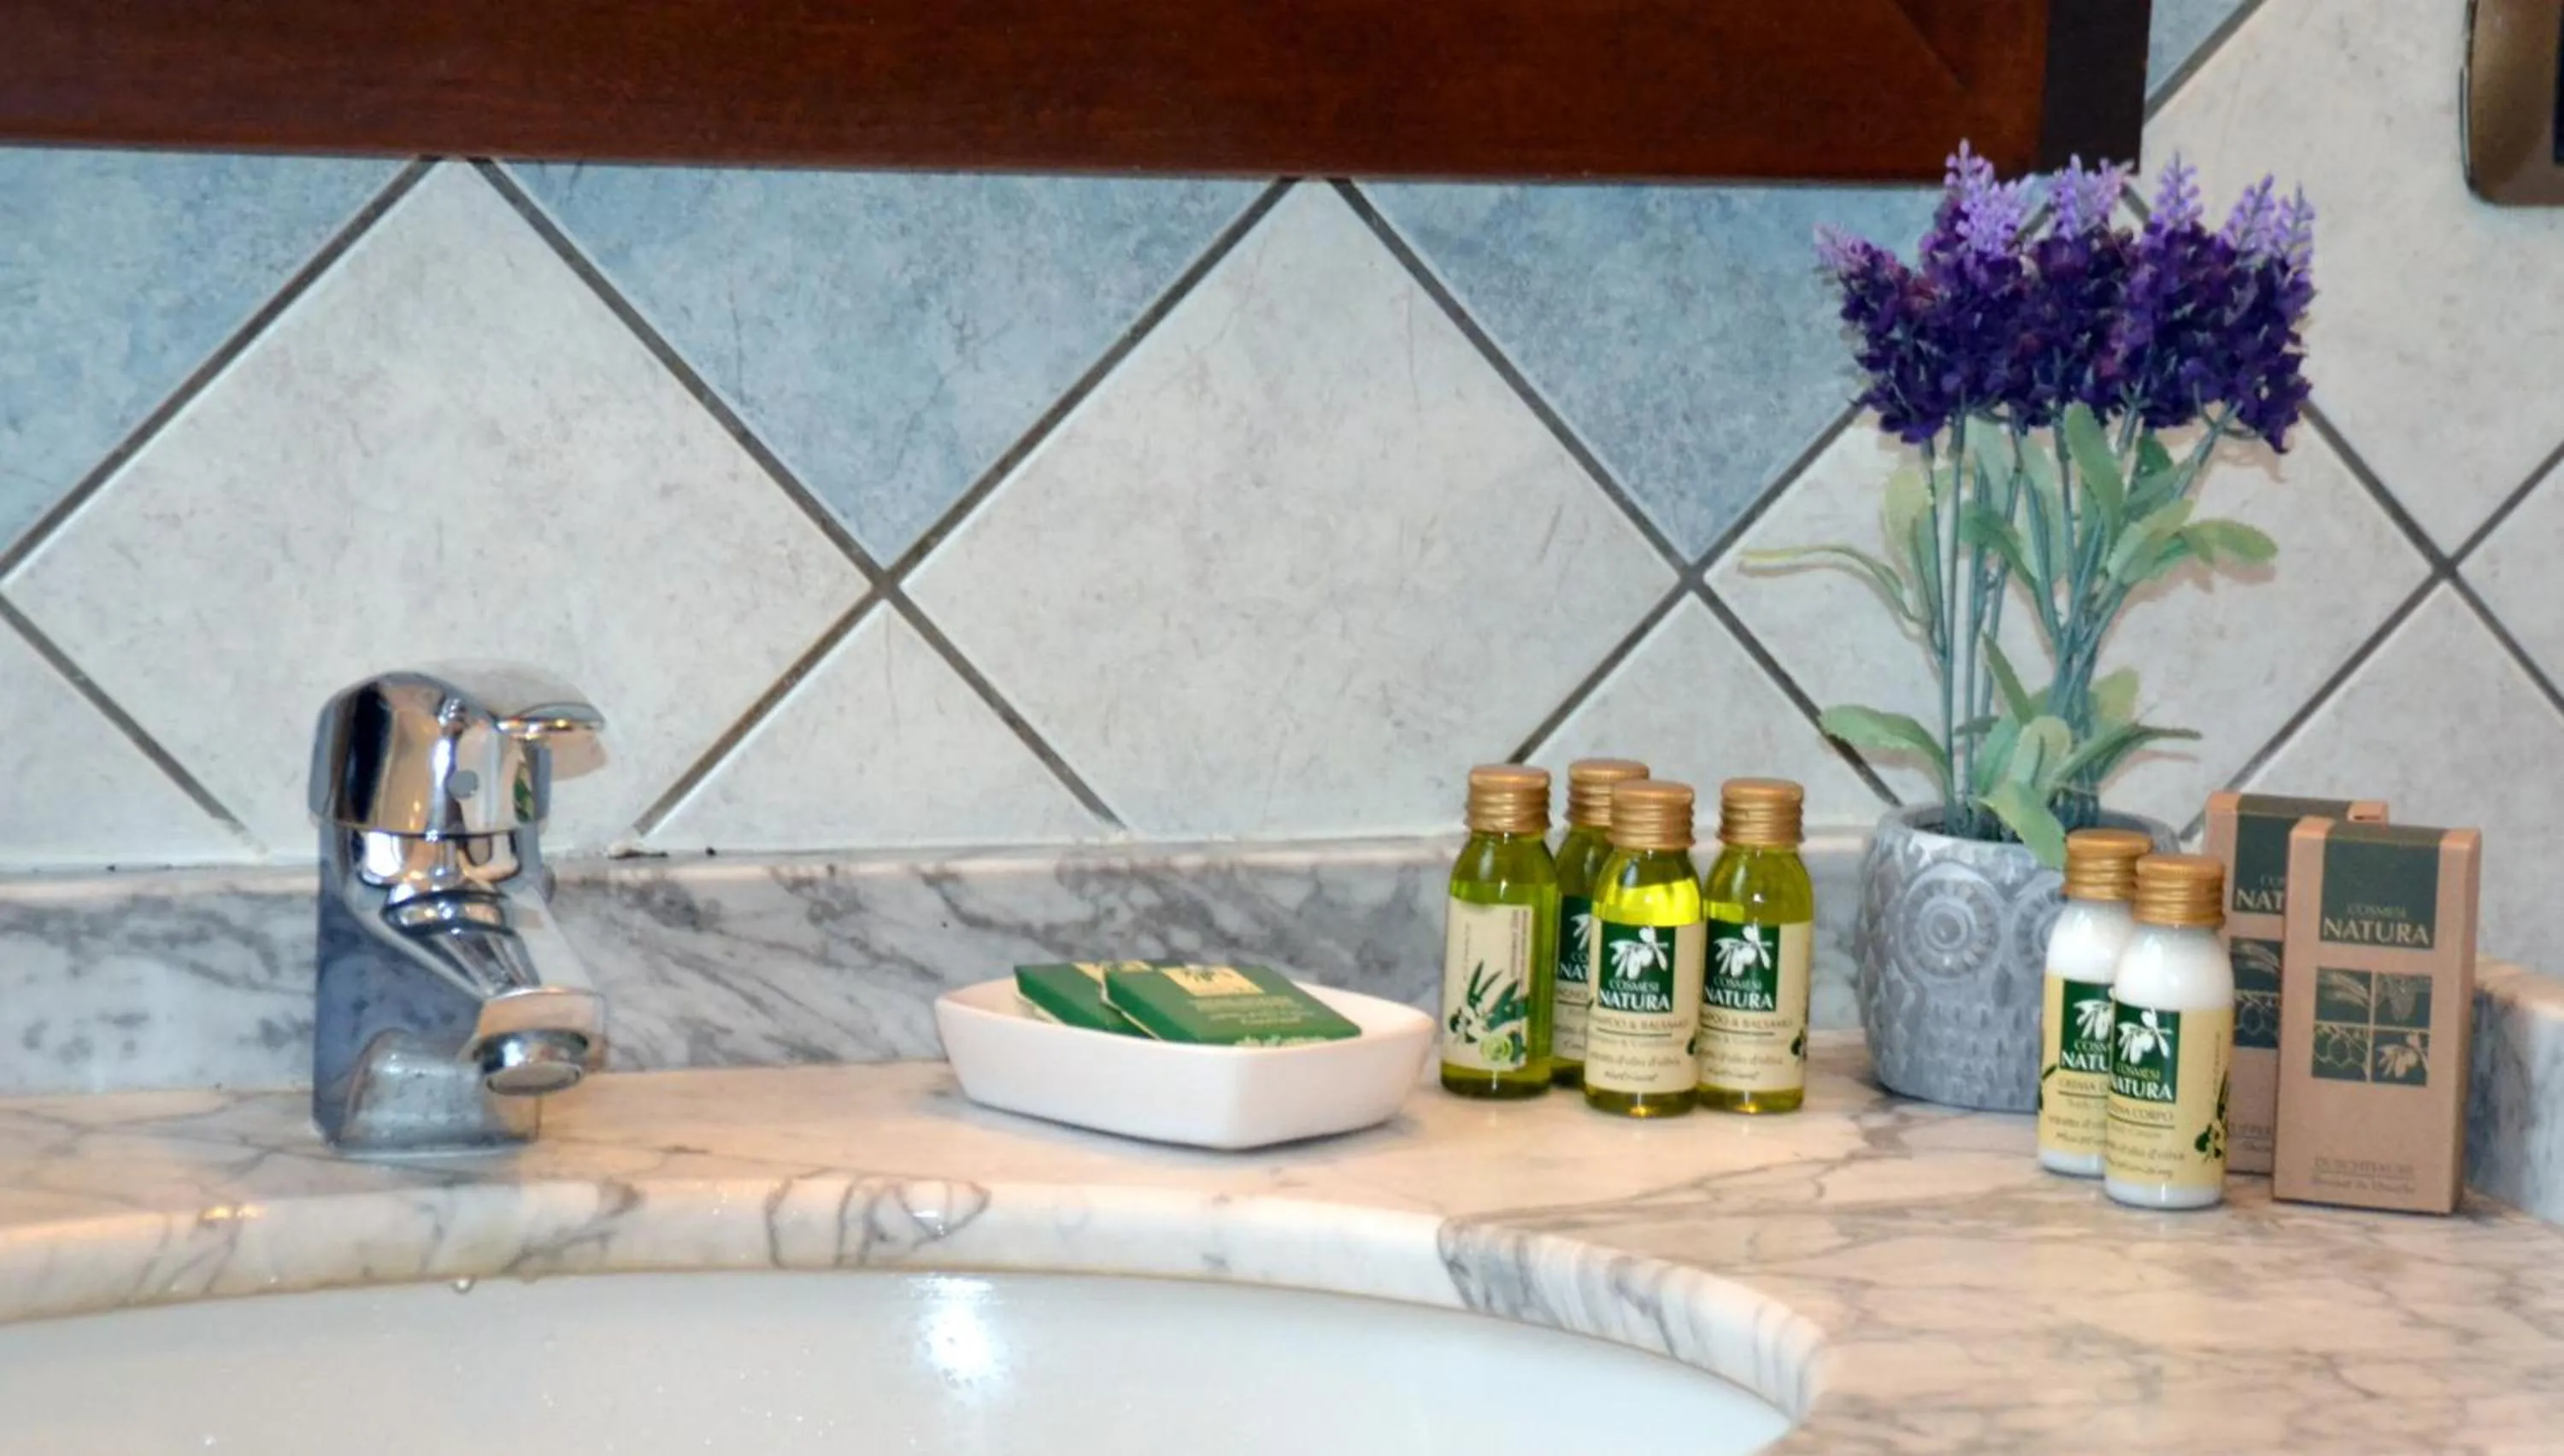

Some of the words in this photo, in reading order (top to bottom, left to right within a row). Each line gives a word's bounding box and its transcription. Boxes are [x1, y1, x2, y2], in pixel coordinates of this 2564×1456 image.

[2237, 888, 2286, 911] NAT
[2323, 915, 2431, 945] NATURA
[1559, 962, 1590, 981] NAT
[1608, 978, 1660, 993] COSMESI
[1704, 983, 1774, 1010] NATURA
[1599, 988, 1671, 1012] NATURA
[2061, 1048, 2108, 1071] NATU
[2108, 1073, 2174, 1102] NATURA
